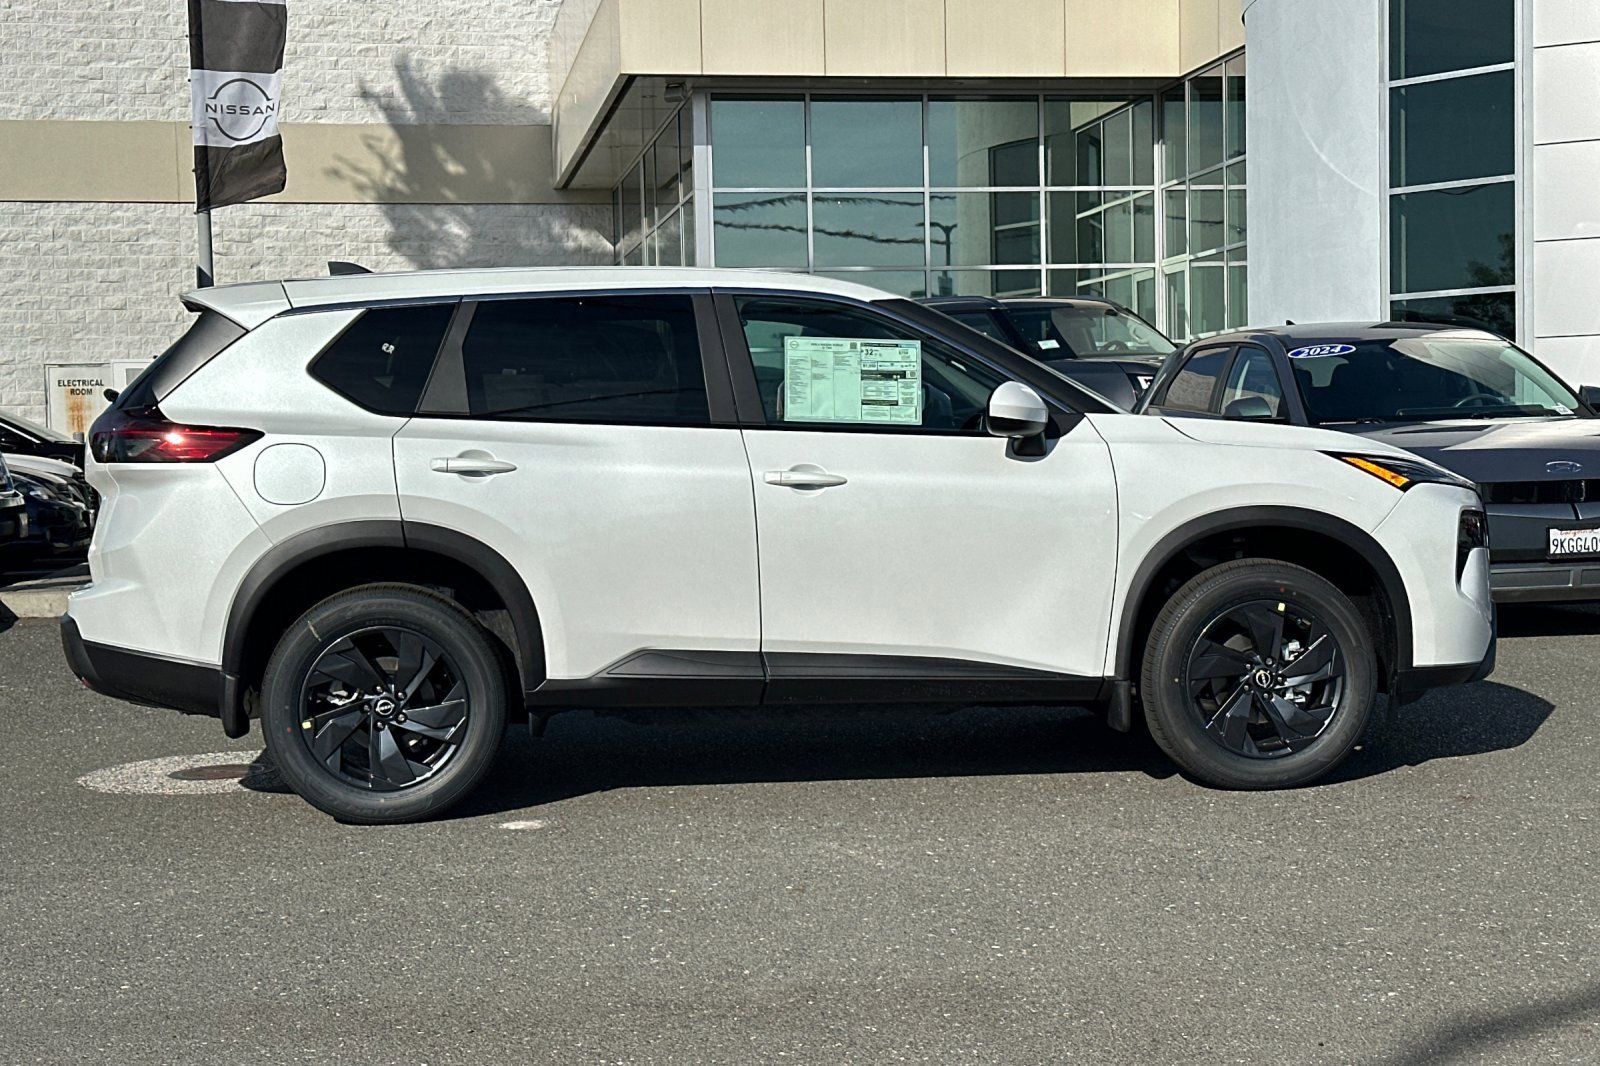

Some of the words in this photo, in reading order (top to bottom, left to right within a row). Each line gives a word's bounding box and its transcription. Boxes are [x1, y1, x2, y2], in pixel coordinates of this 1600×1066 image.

[205, 102, 274, 115] NISSAN
[1299, 344, 1342, 358] 2024
[57, 379, 104, 387] ELECTRICAL
[70, 388, 93, 396] ROOM
[1552, 536, 1600, 554] 9KGG40
